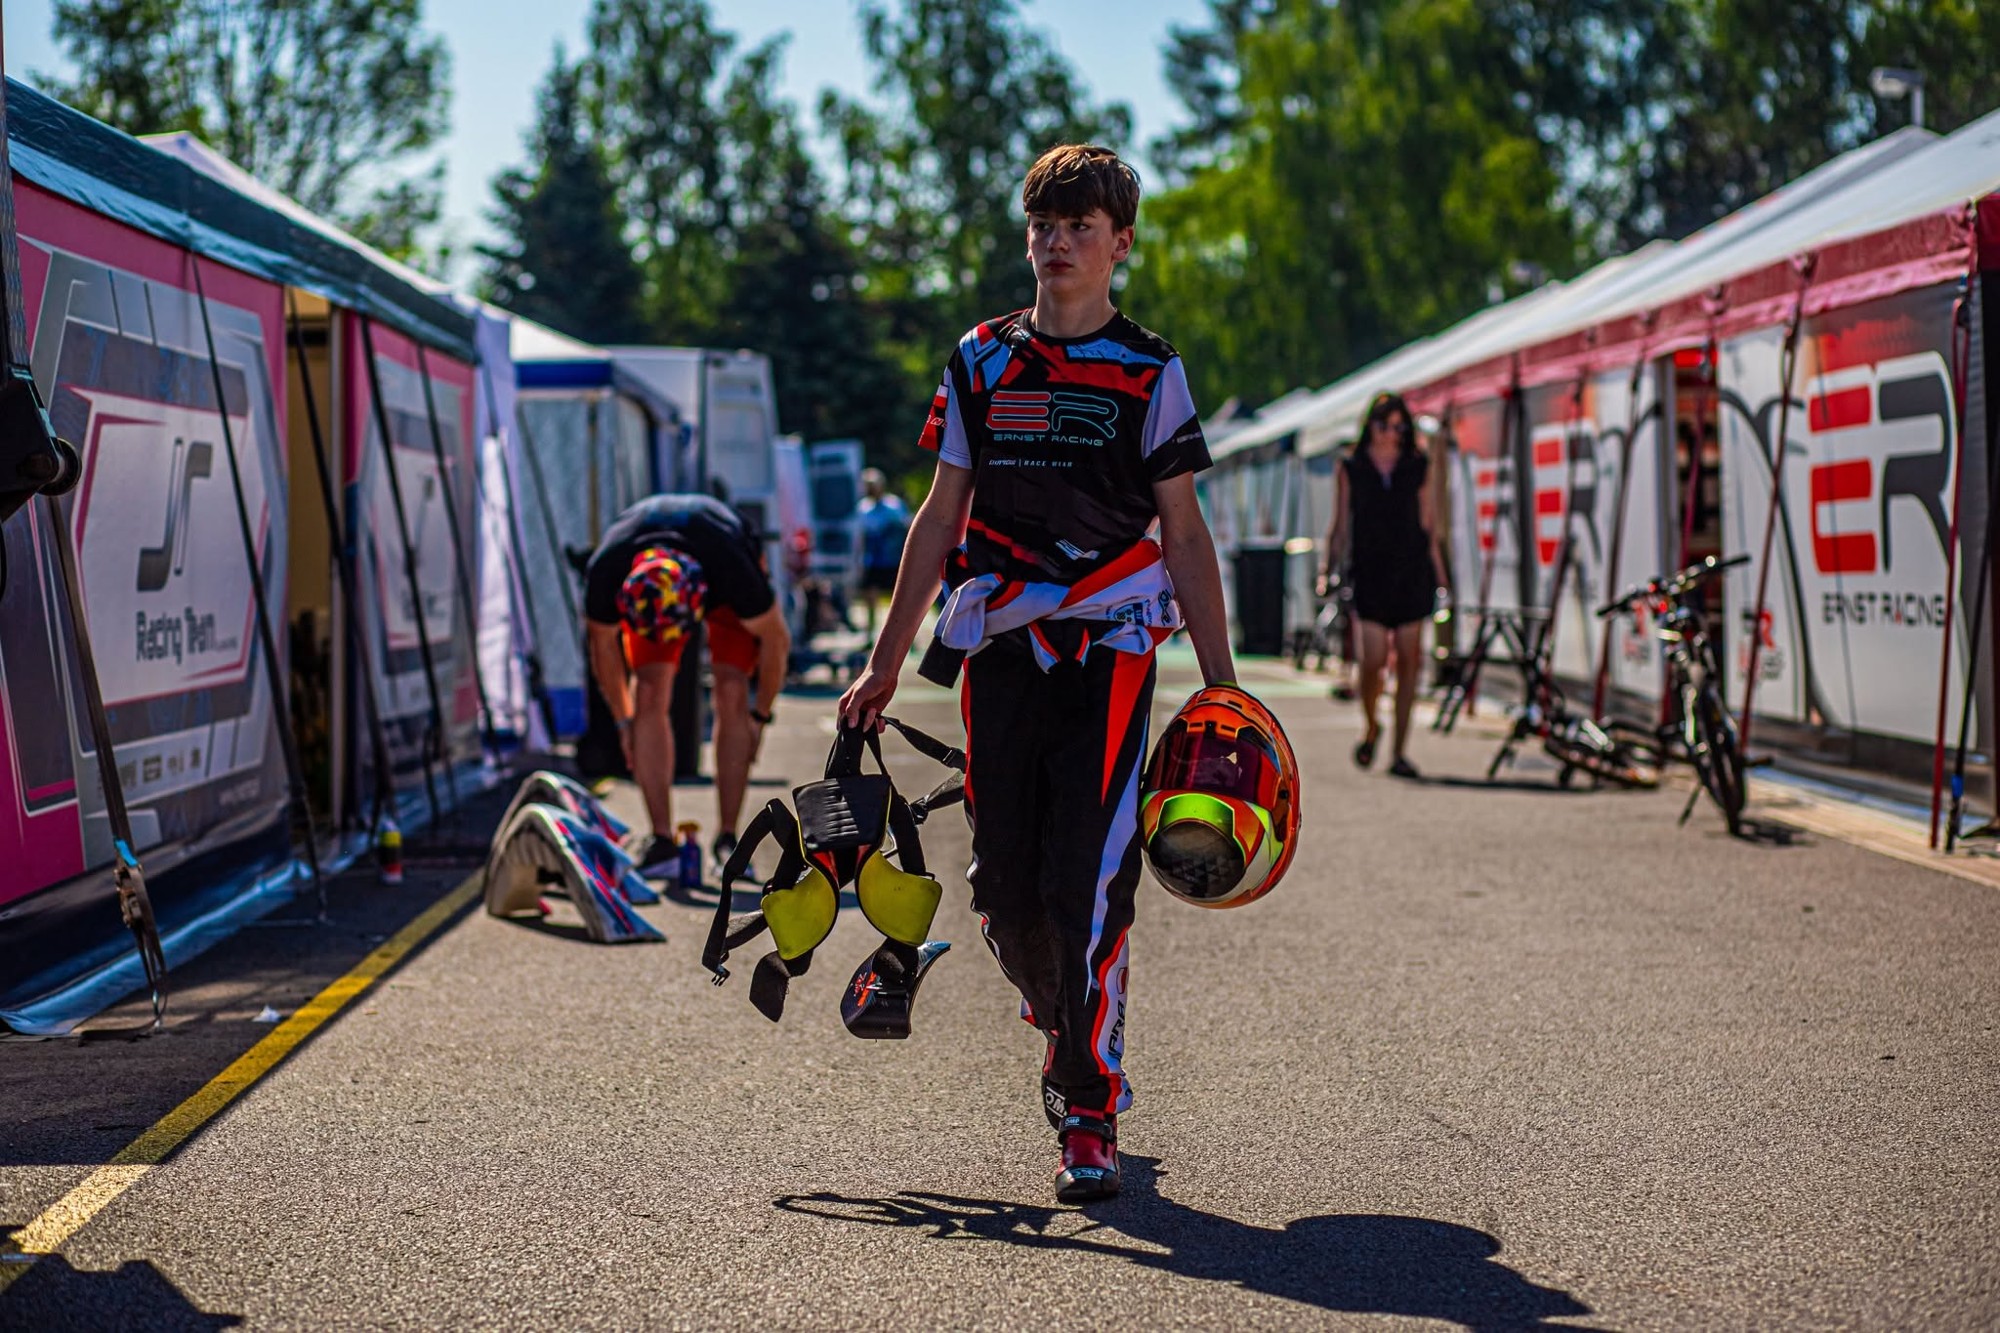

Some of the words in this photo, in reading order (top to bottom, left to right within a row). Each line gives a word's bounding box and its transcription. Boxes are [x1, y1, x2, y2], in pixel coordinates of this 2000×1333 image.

[985, 390, 1119, 439] ER
[993, 433, 1046, 442] ERNST
[1051, 435, 1104, 447] RACING
[1809, 369, 1954, 575] ER
[1534, 432, 1602, 567] ER
[1822, 593, 1877, 624] ERNST
[136, 610, 182, 665] Racing
[1045, 1091, 1068, 1117] OM
